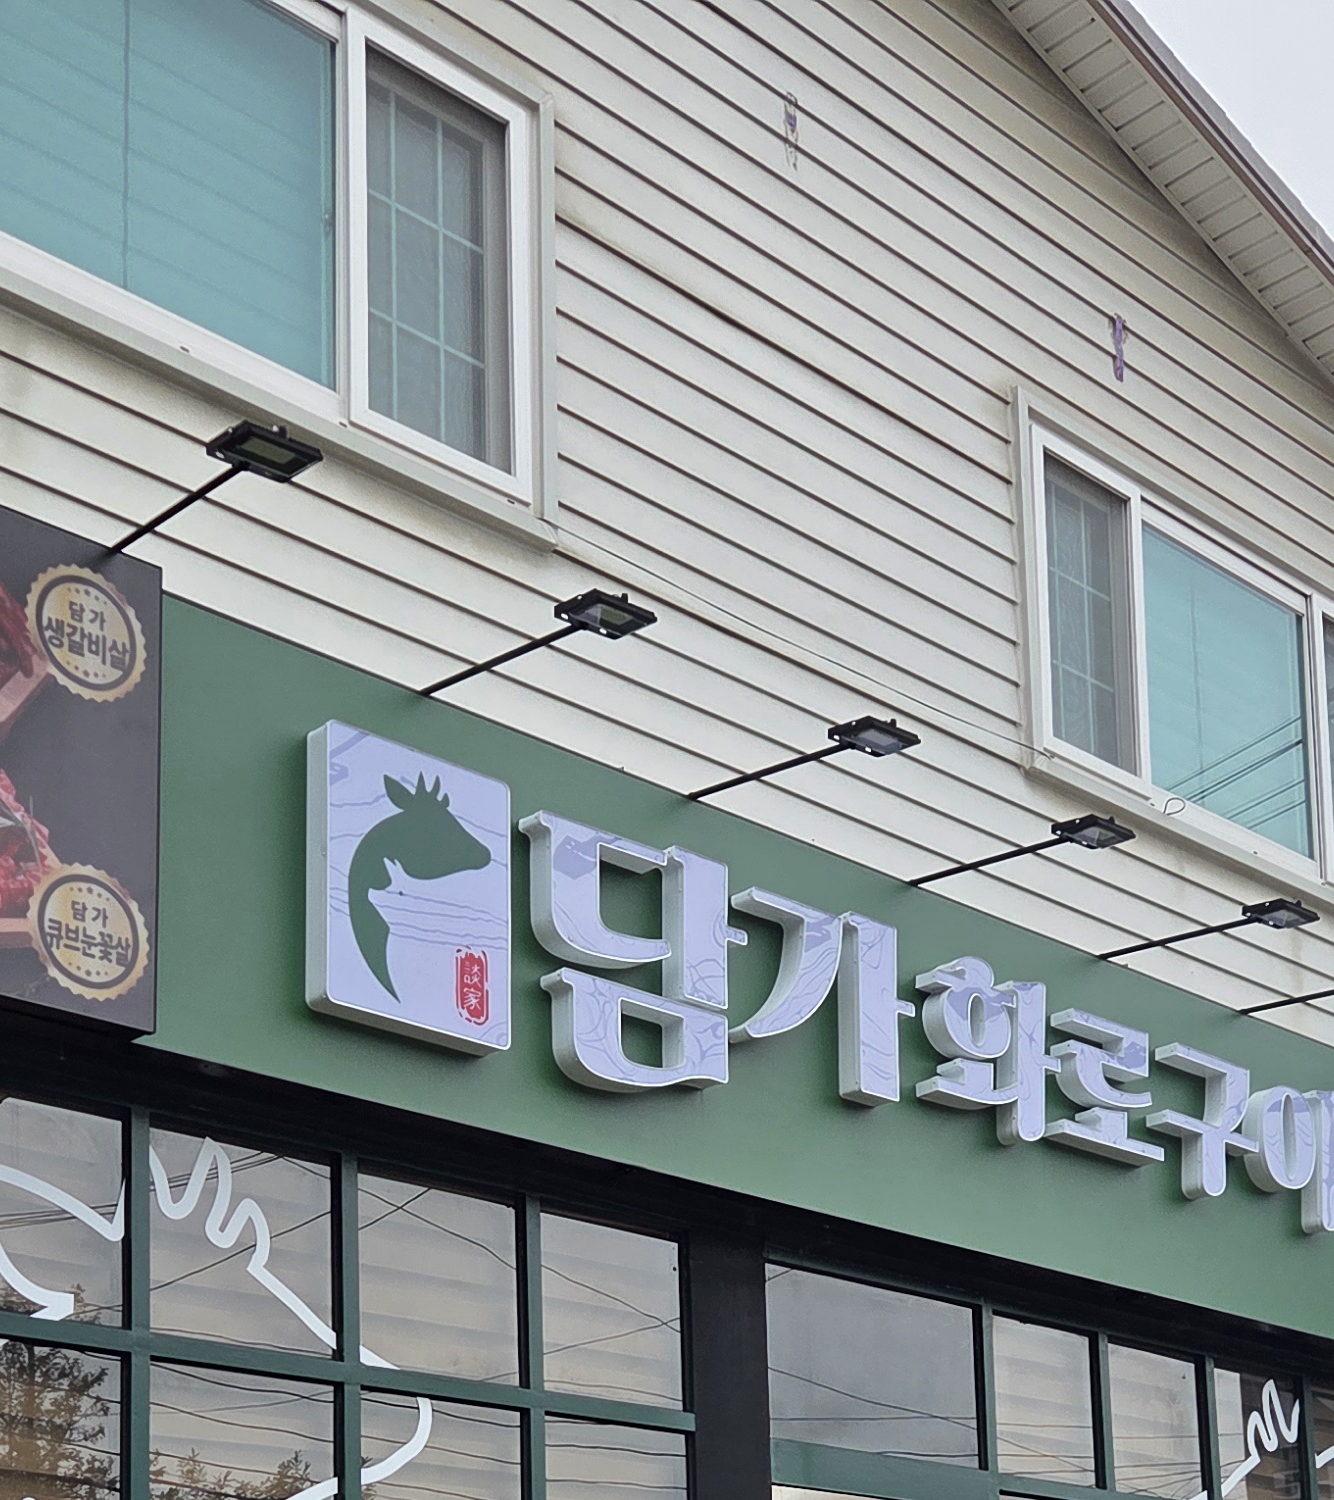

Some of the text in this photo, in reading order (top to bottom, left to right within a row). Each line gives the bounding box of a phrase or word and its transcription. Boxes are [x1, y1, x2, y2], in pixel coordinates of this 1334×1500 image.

[69, 600, 107, 632] 담가
[43, 615, 131, 671] 생갈비살
[71, 900, 108, 929] 담가
[46, 917, 131, 968] 큐브눈꽃살
